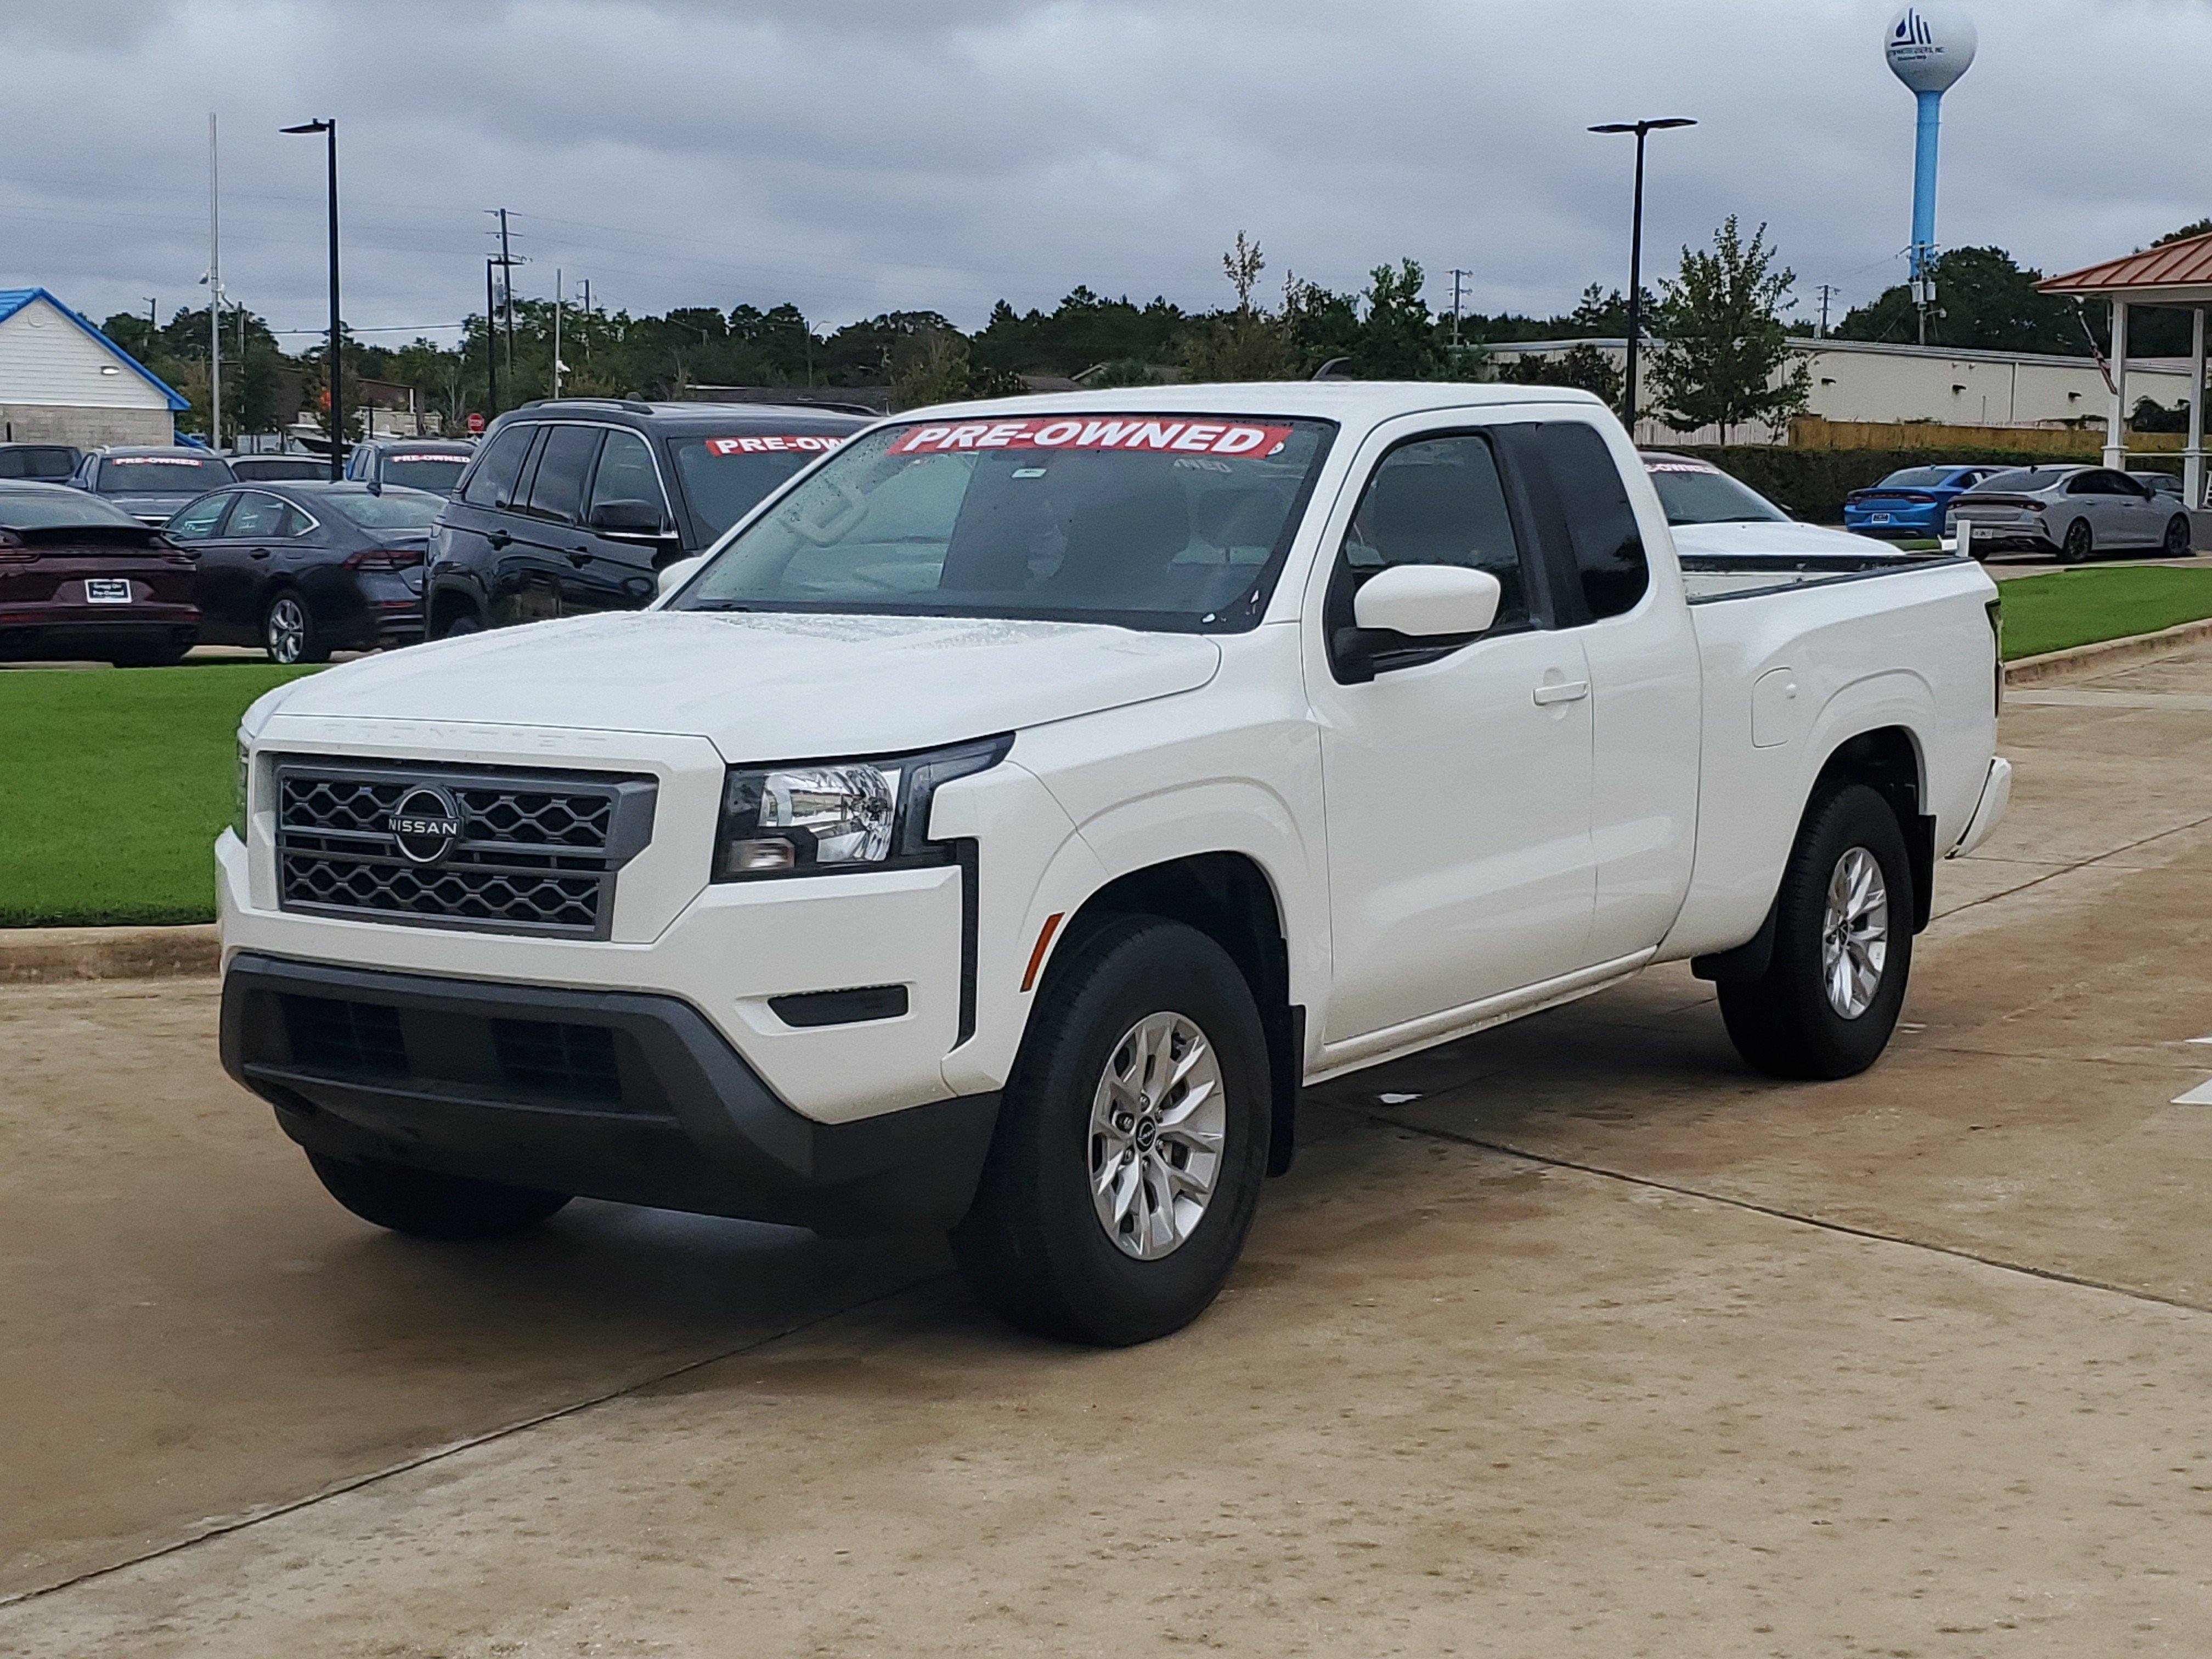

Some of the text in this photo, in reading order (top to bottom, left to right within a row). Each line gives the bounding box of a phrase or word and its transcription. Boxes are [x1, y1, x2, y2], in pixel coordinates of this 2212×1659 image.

[901, 421, 1266, 454] PRE-OWNED
[116, 457, 199, 466] PRE-OWNED
[388, 818, 457, 835] NISSAN
